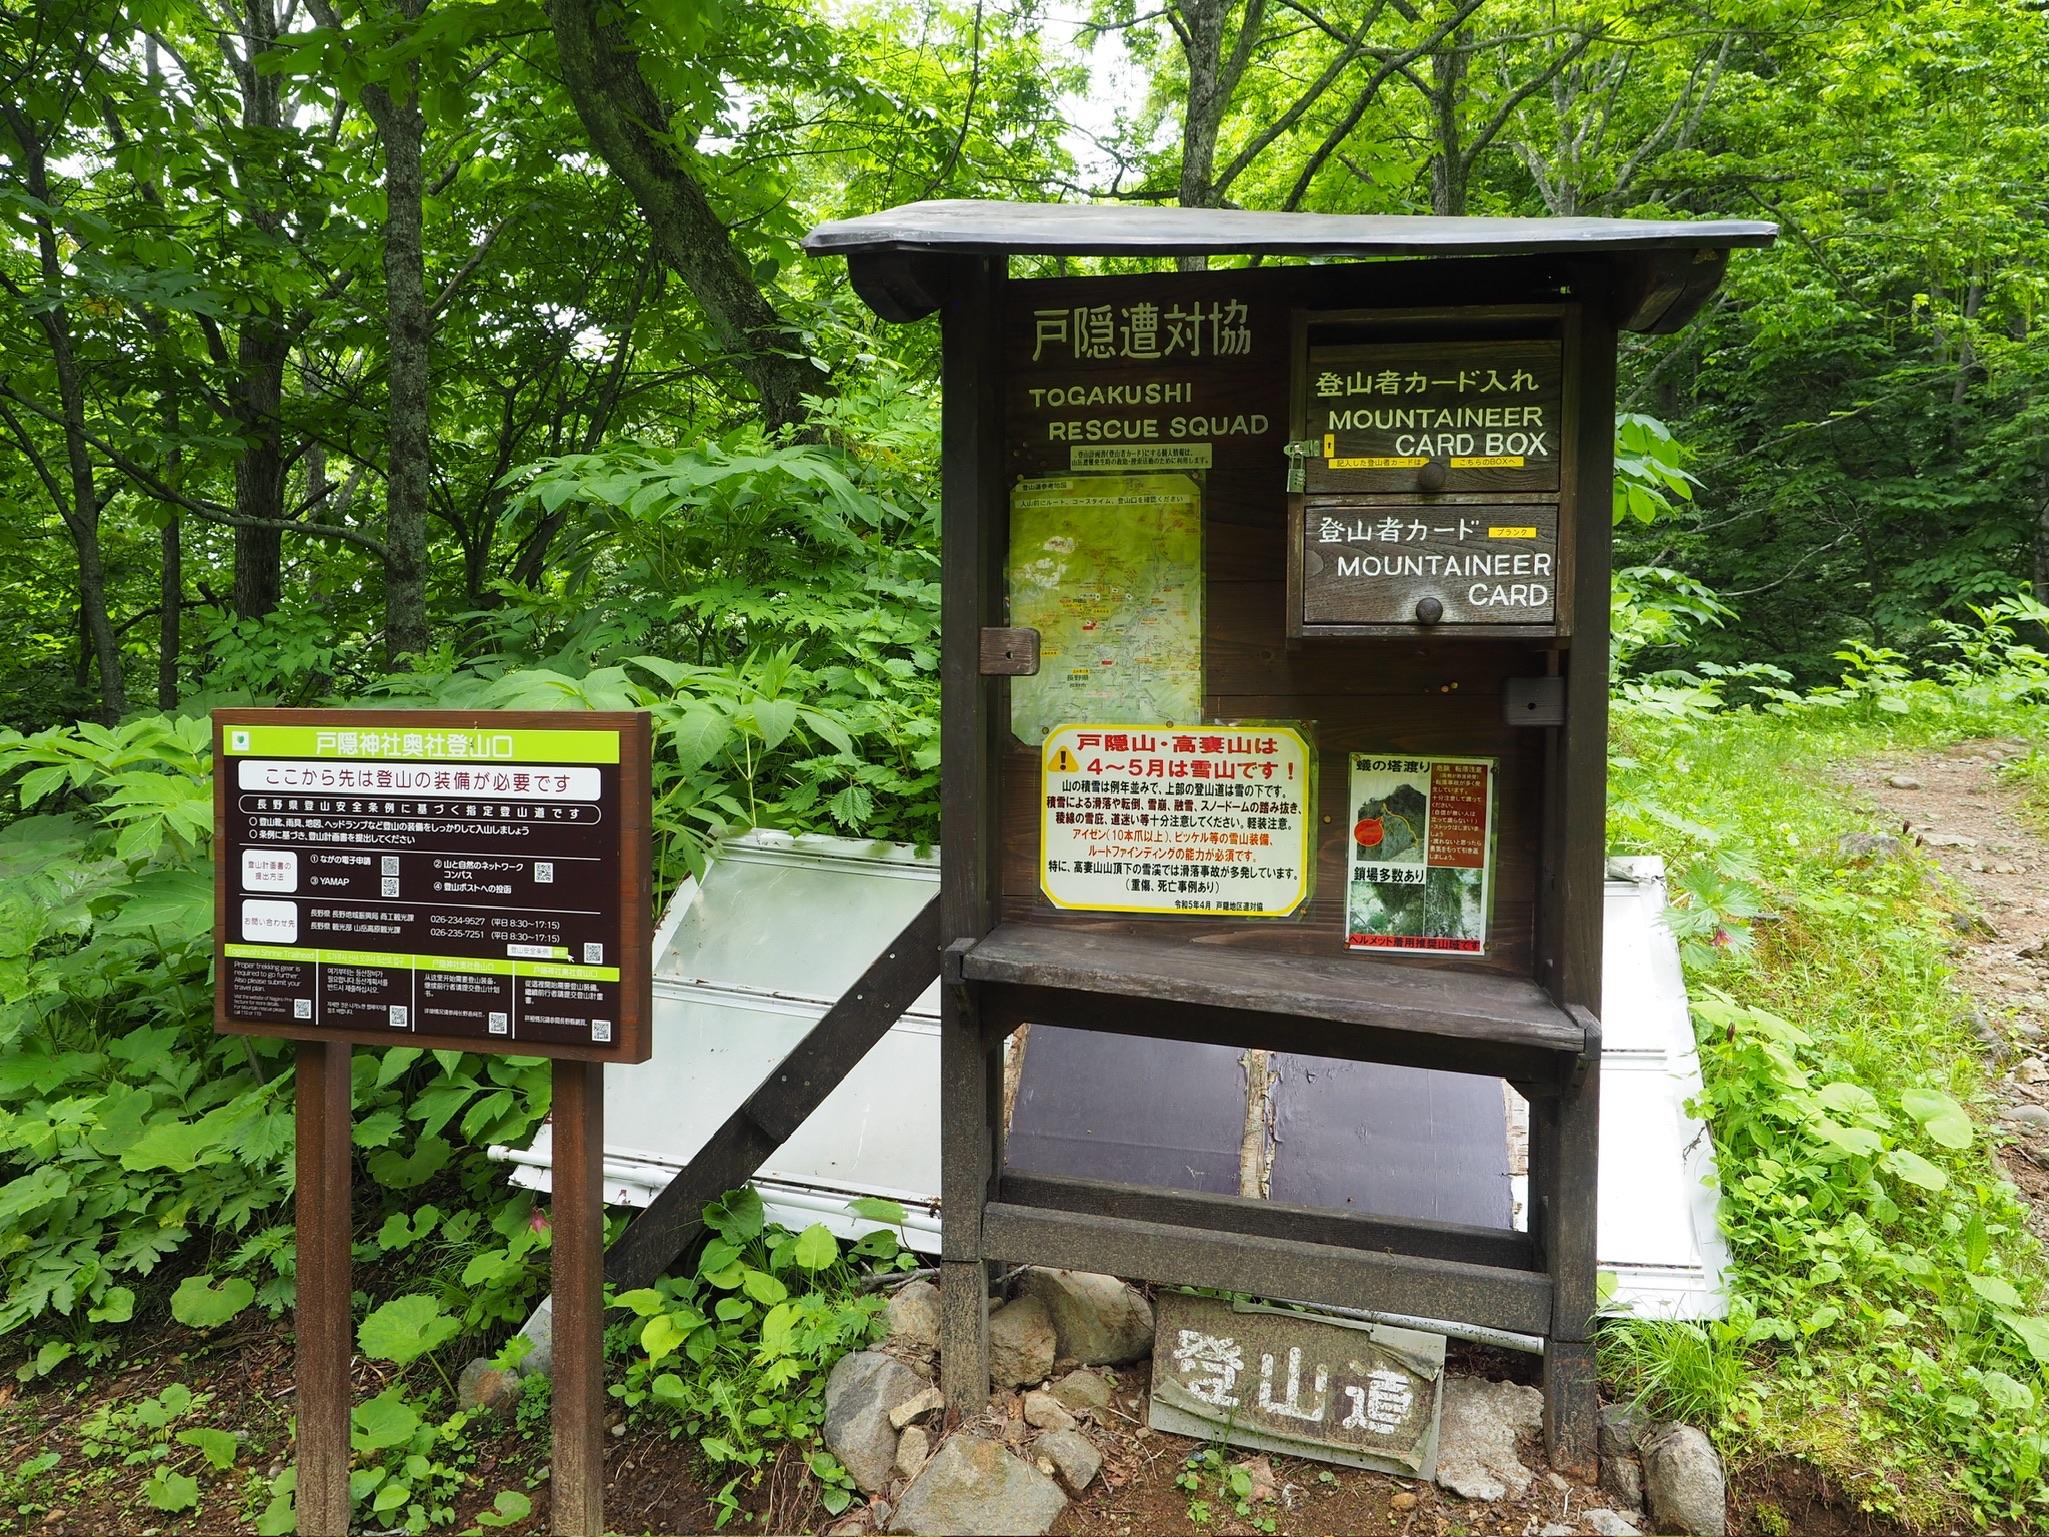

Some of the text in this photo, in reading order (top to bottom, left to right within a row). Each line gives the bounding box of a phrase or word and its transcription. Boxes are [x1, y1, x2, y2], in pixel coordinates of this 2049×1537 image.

[1032, 298, 1251, 362] 戸隠遭対協
[1029, 382, 1192, 408] TOGAKUSHI
[1315, 369, 1539, 398] 登山者カード入れ
[1049, 414, 1269, 441] RESCUE SQUAD
[1329, 407, 1543, 430] MOUNTAINEER
[1396, 432, 1548, 457] CARD BOX
[1336, 458, 1421, 467] 記入した登山者カードは
[1459, 457, 1516, 466] こちらのBOXへ
[1318, 516, 1479, 543] 登山者カード
[1338, 553, 1551, 577] MOUNTAINEER
[1468, 583, 1548, 606] CARD
[315, 731, 513, 758] 戸隠神社奥社登山口
[1077, 733, 1279, 754] 戸隠山・高妻山は
[1356, 760, 1430, 774] 蟻の塔渡り
[266, 768, 571, 793] ここから先は登山の装備が必要です
[1062, 780, 1287, 799] 山の積雪は例年並みで、上部の登山道は雪の下です。
[257, 798, 580, 819] 長野県登山安全条例に基づく指定登山道です
[320, 877, 350, 886] YAMAP
[1354, 866, 1424, 883] 鎖場多数あり
[1174, 900, 1211, 910] 令和5年4月
[430, 915, 485, 926] 026-234-9527
[430, 928, 484, 939] 026-235-7251
[1173, 1329, 1413, 1434] 登山道
